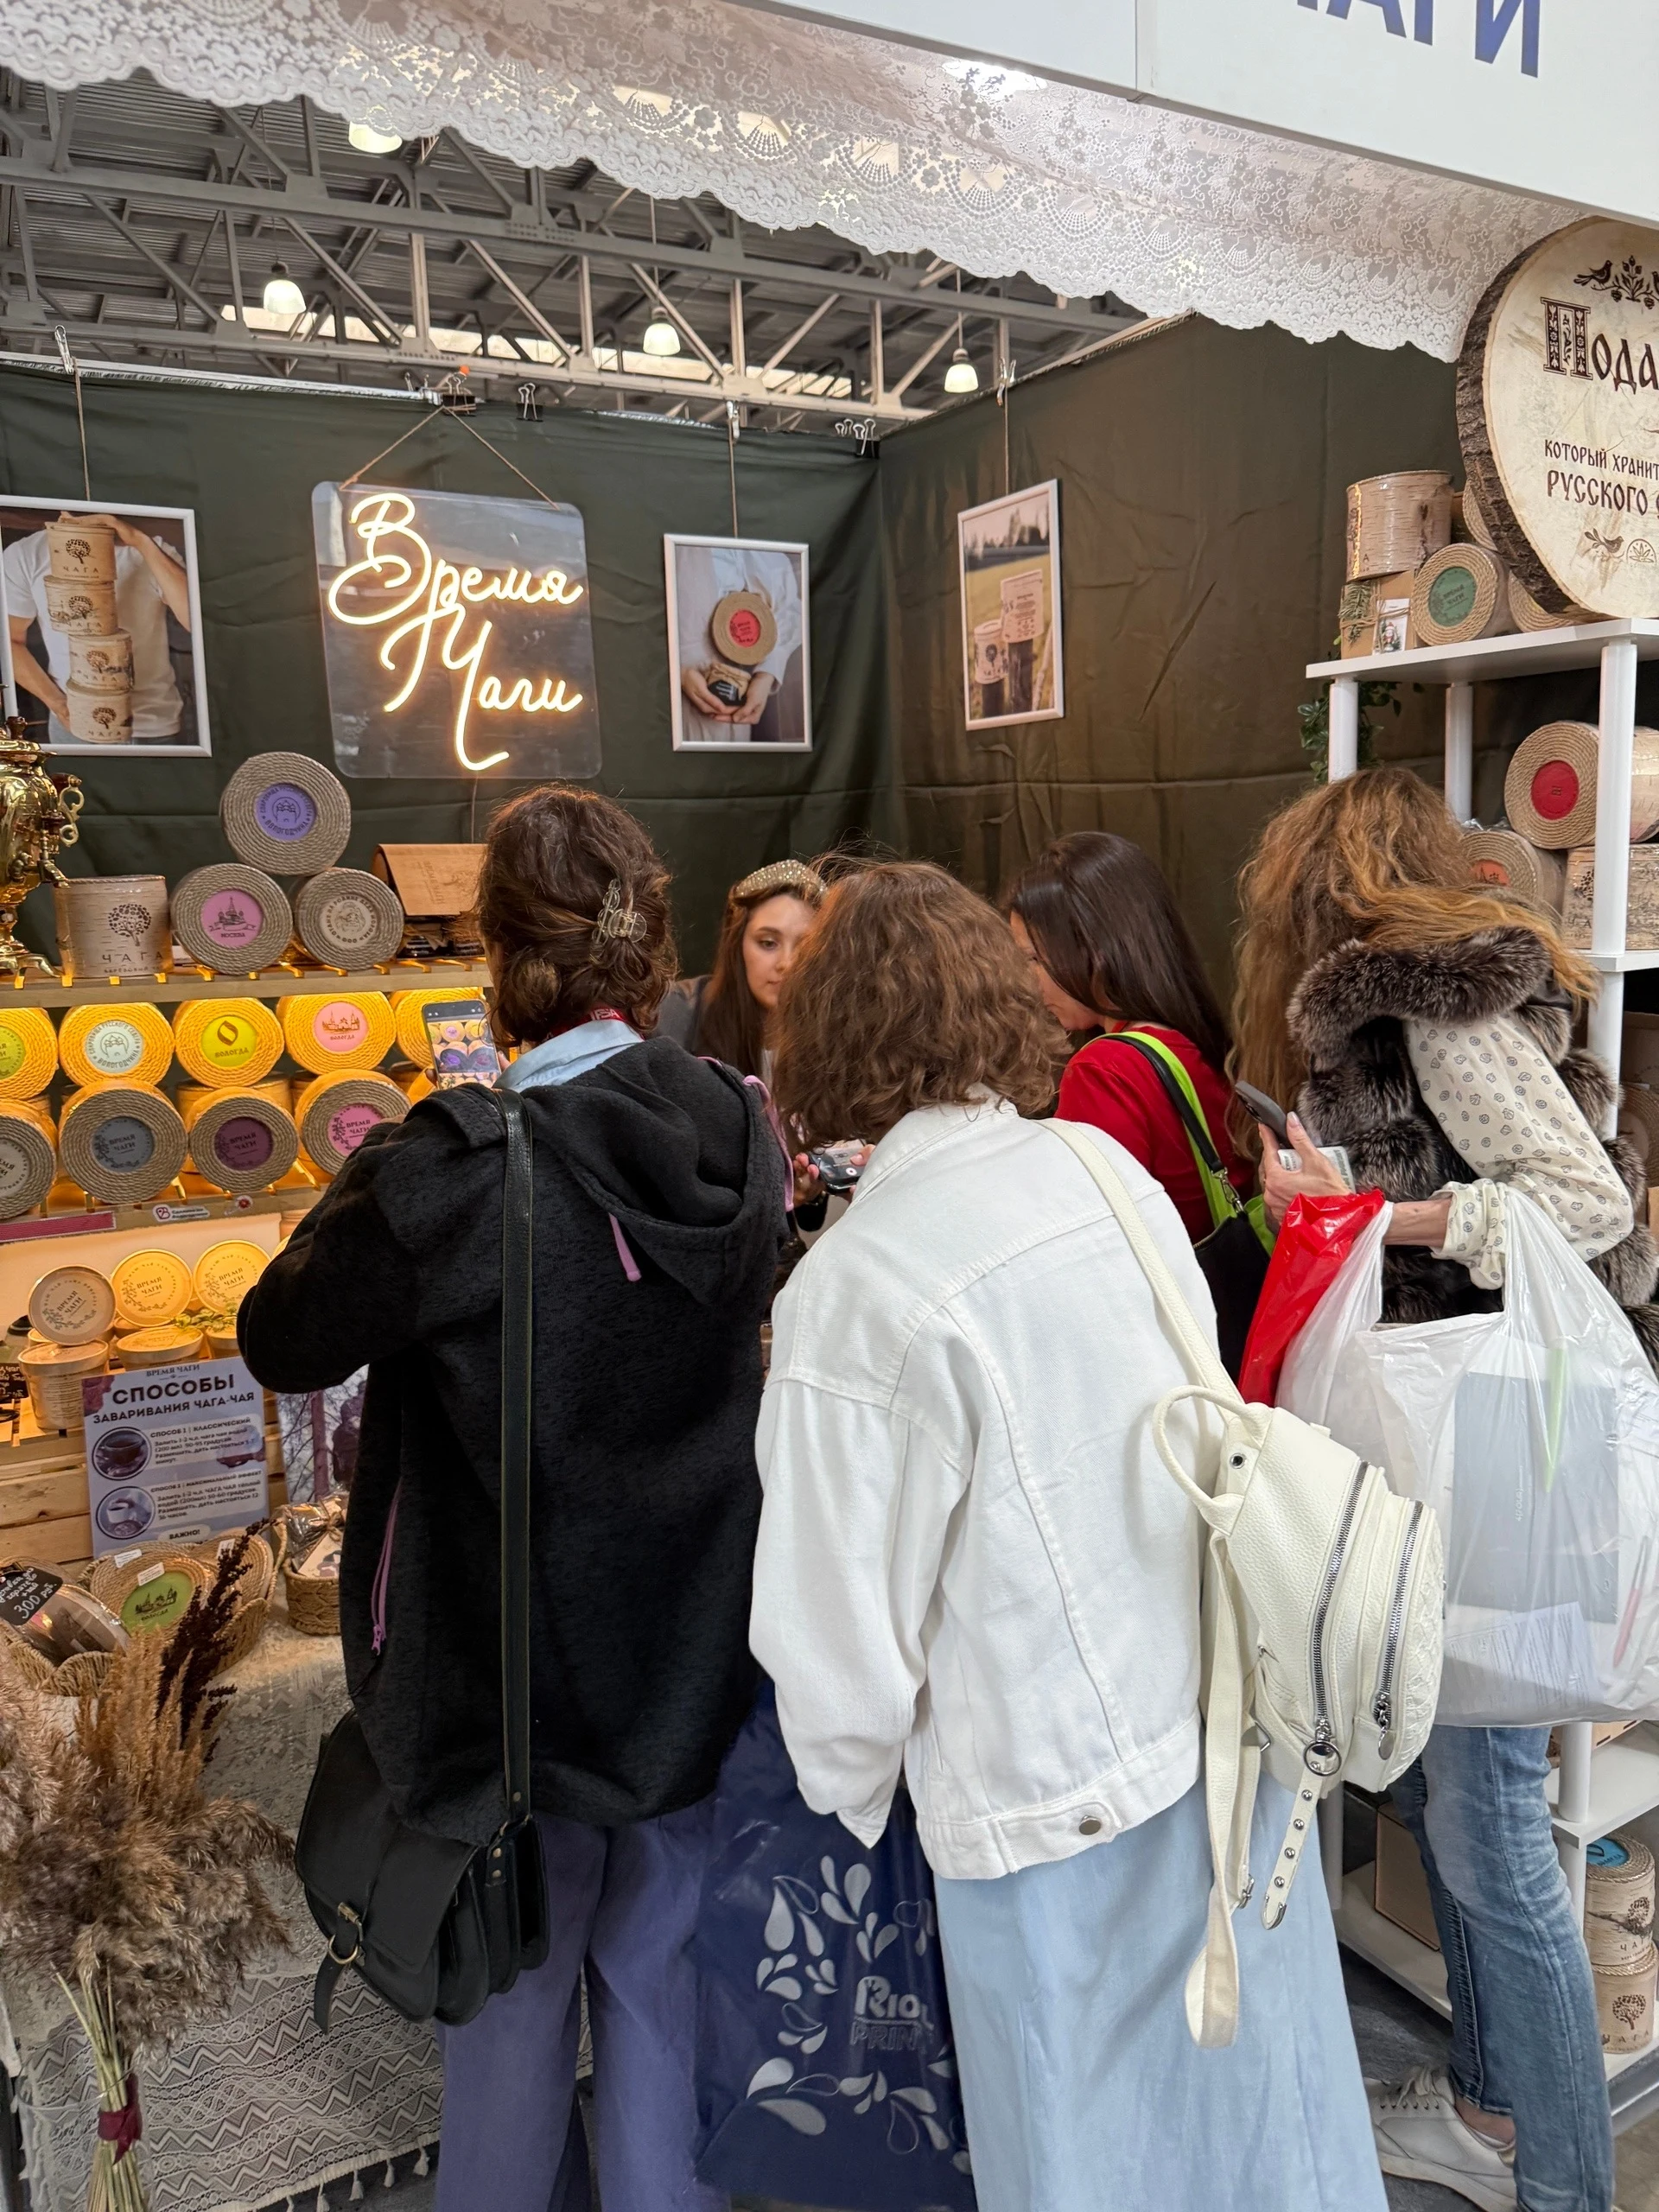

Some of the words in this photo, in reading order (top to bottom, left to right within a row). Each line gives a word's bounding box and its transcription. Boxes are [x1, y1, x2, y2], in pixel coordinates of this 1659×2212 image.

[1544, 439, 1607, 469] КОТОРЫЙ
[1548, 469, 1648, 516] РУССКОГО
[328, 493, 584, 712] Время
[380, 604, 584, 771] Чаги
[102, 951, 163, 963] ЧАГА
[346, 1119, 371, 1128] ВРЕМЯ
[137, 1276, 162, 1289] ВРЕМЯ
[219, 1268, 244, 1281] ВРЕМЯ
[224, 1275, 245, 1286] ЧАГИ
[141, 1284, 162, 1294] ЧАГИ
[57, 1290, 78, 1312] ВРЕМЯ
[65, 1297, 83, 1313] ЧАГИ
[146, 1368, 175, 1376] ВРЕМЯ
[177, 1363, 200, 1373] ЧАГИ
[112, 1374, 234, 1405] СПОСОБЫ
[93, 1402, 190, 1424] ЗАВАРИВАНИЯ
[194, 1392, 254, 1409] ЧАГА-ЧАЯ
[150, 1429, 181, 1438] СПОСОБ
[194, 1417, 251, 1432] КЛАССИЧЕСКИЙ
[168, 1529, 200, 1540] ВАЖНО!
[14, 1595, 41, 1619] 300
